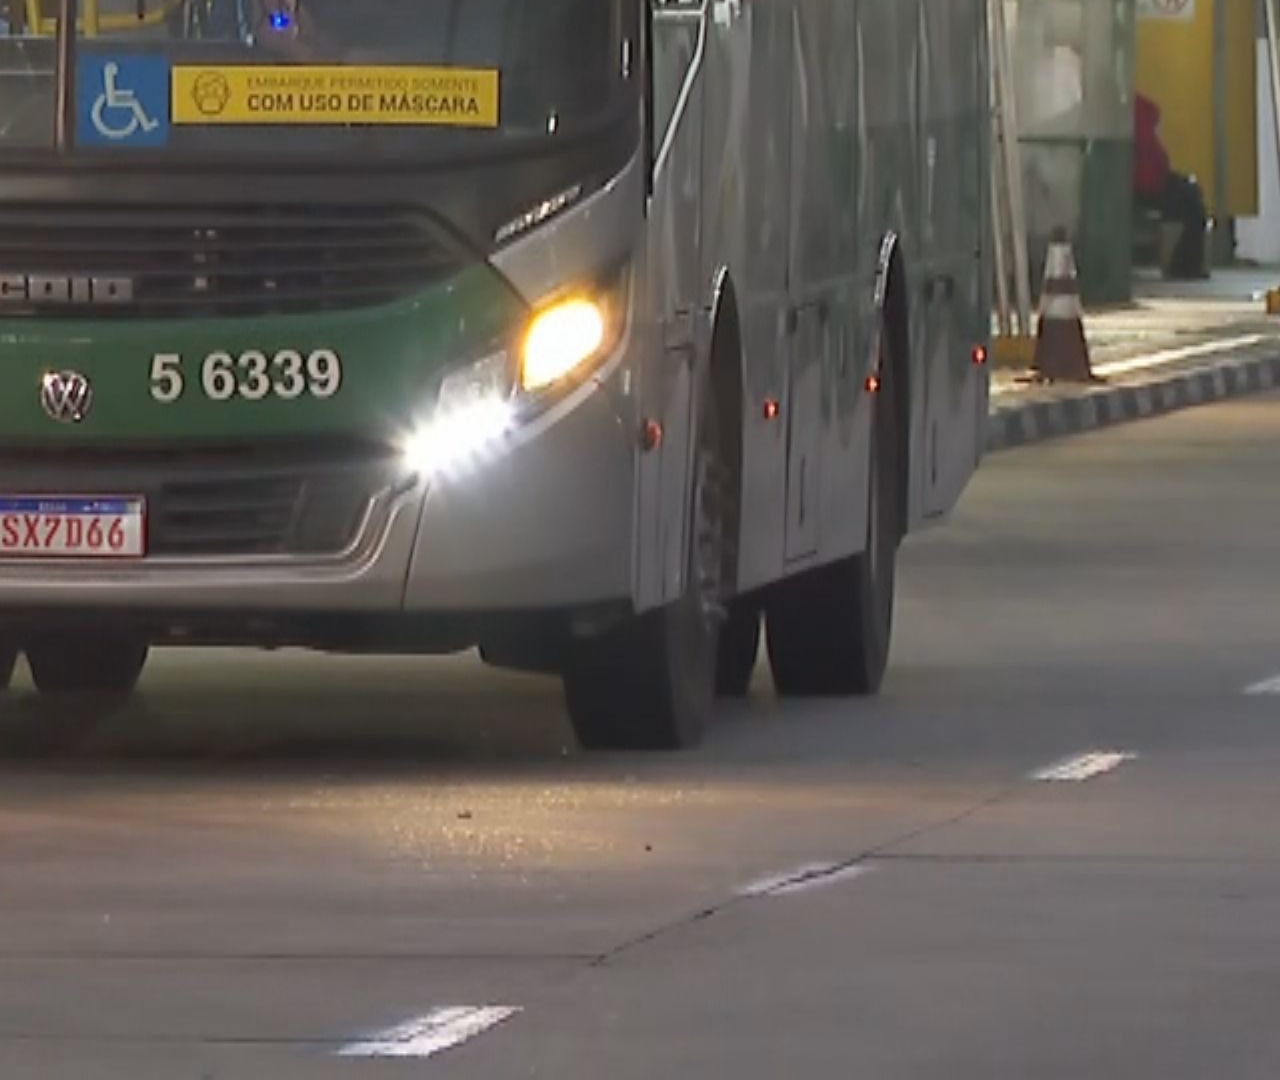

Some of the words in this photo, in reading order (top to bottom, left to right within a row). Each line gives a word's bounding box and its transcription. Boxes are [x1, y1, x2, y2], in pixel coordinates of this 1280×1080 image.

[246, 76, 326, 91] EMBARQUE
[329, 76, 408, 92] PERMITIDO
[411, 77, 480, 93] SOMENTE
[247, 93, 294, 112] COM
[299, 93, 342, 112] USO
[347, 94, 375, 112] DE
[379, 88, 481, 115] MÁSCARA
[150, 352, 184, 402] 5
[201, 348, 341, 400] 6339
